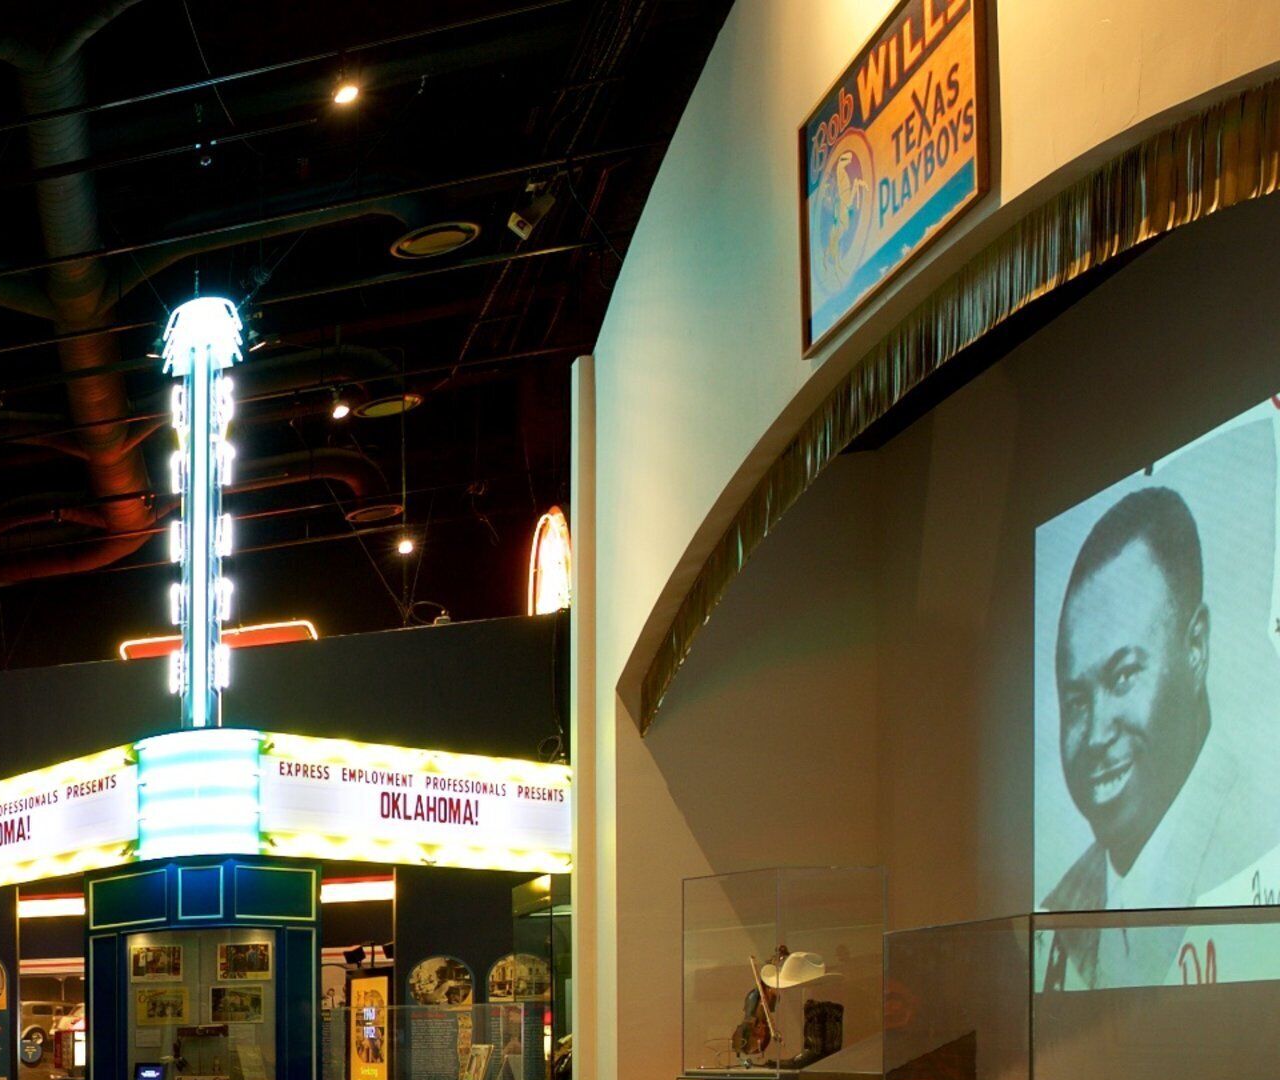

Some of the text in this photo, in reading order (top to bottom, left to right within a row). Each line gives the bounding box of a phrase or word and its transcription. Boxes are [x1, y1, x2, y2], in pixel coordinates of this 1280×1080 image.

[891, 62, 959, 166] TEXAS
[878, 97, 975, 229] PLAYBOYS
[66, 774, 117, 800] PRESENTS
[279, 761, 565, 803] EXPRESS EMPLOYMENT PROFESSIONALS PRESENTS
[381, 791, 480, 826] OKLAHOMA!
